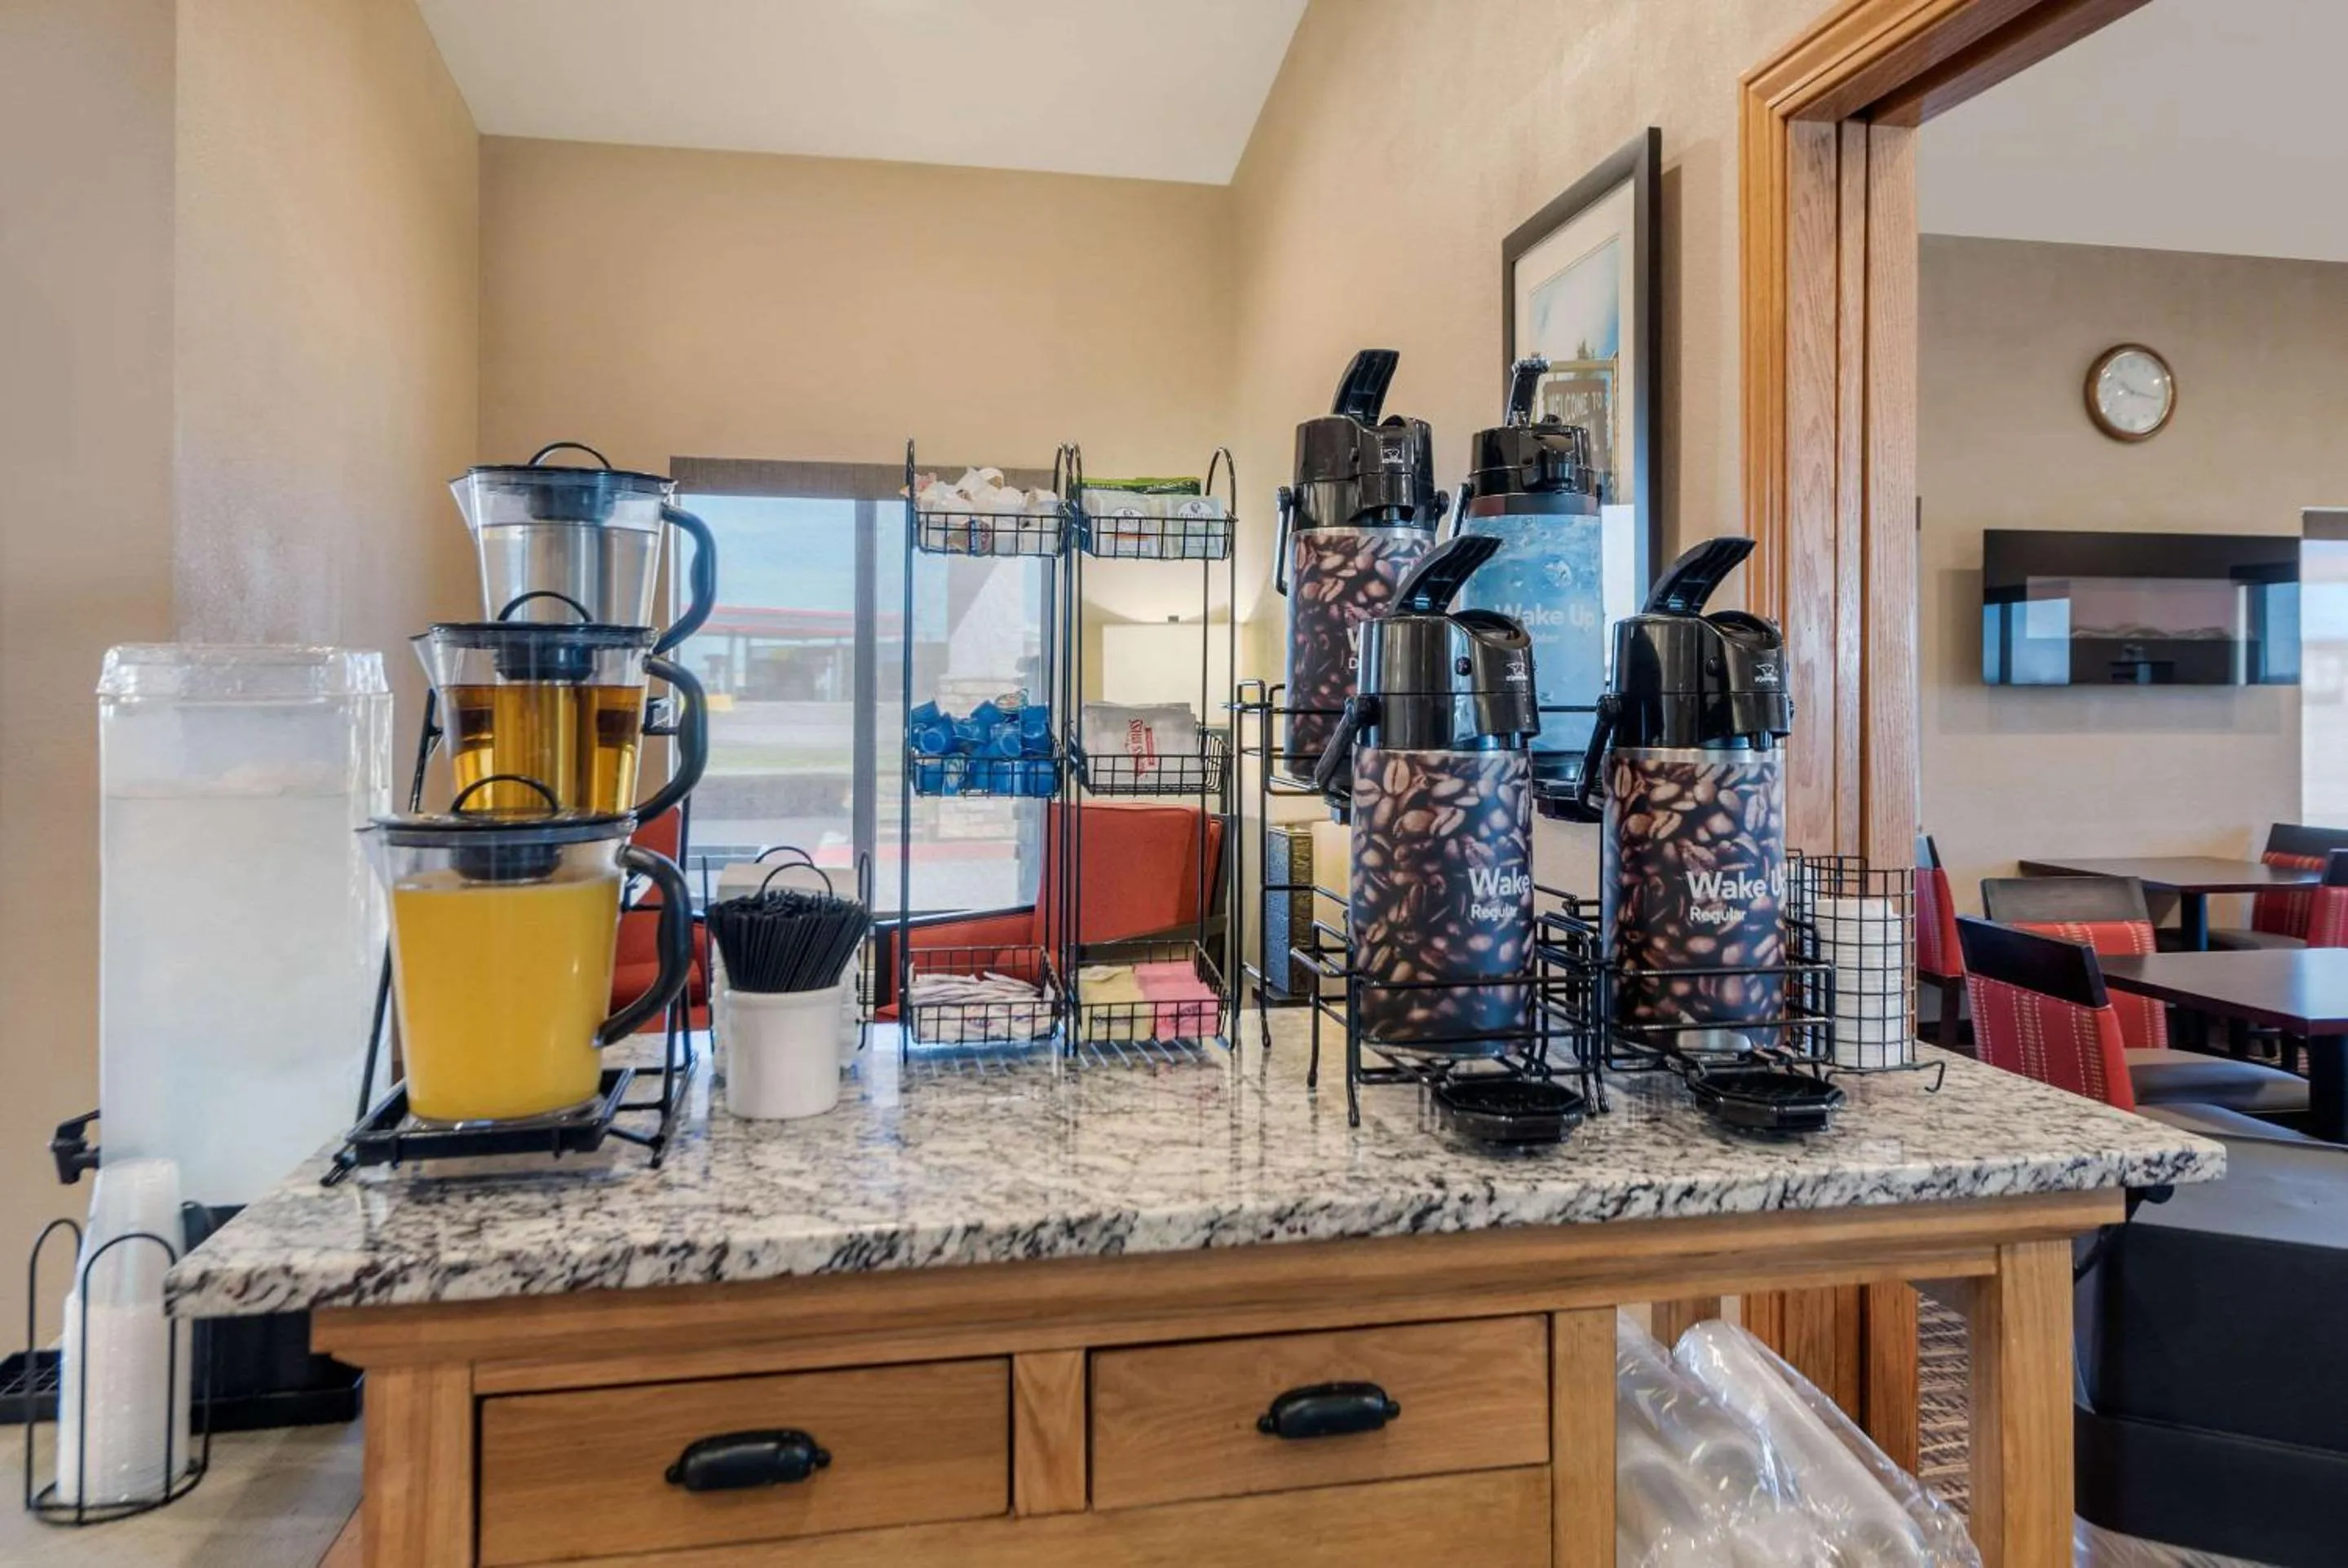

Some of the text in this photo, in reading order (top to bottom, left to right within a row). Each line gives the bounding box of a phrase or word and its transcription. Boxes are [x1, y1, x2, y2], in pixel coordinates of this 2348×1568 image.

[1494, 603, 1564, 626] Wake
[1468, 867, 1531, 897] Wake
[1686, 870, 1767, 900] Wake
[1470, 903, 1518, 921] Regular
[1690, 906, 1747, 925] Regular
